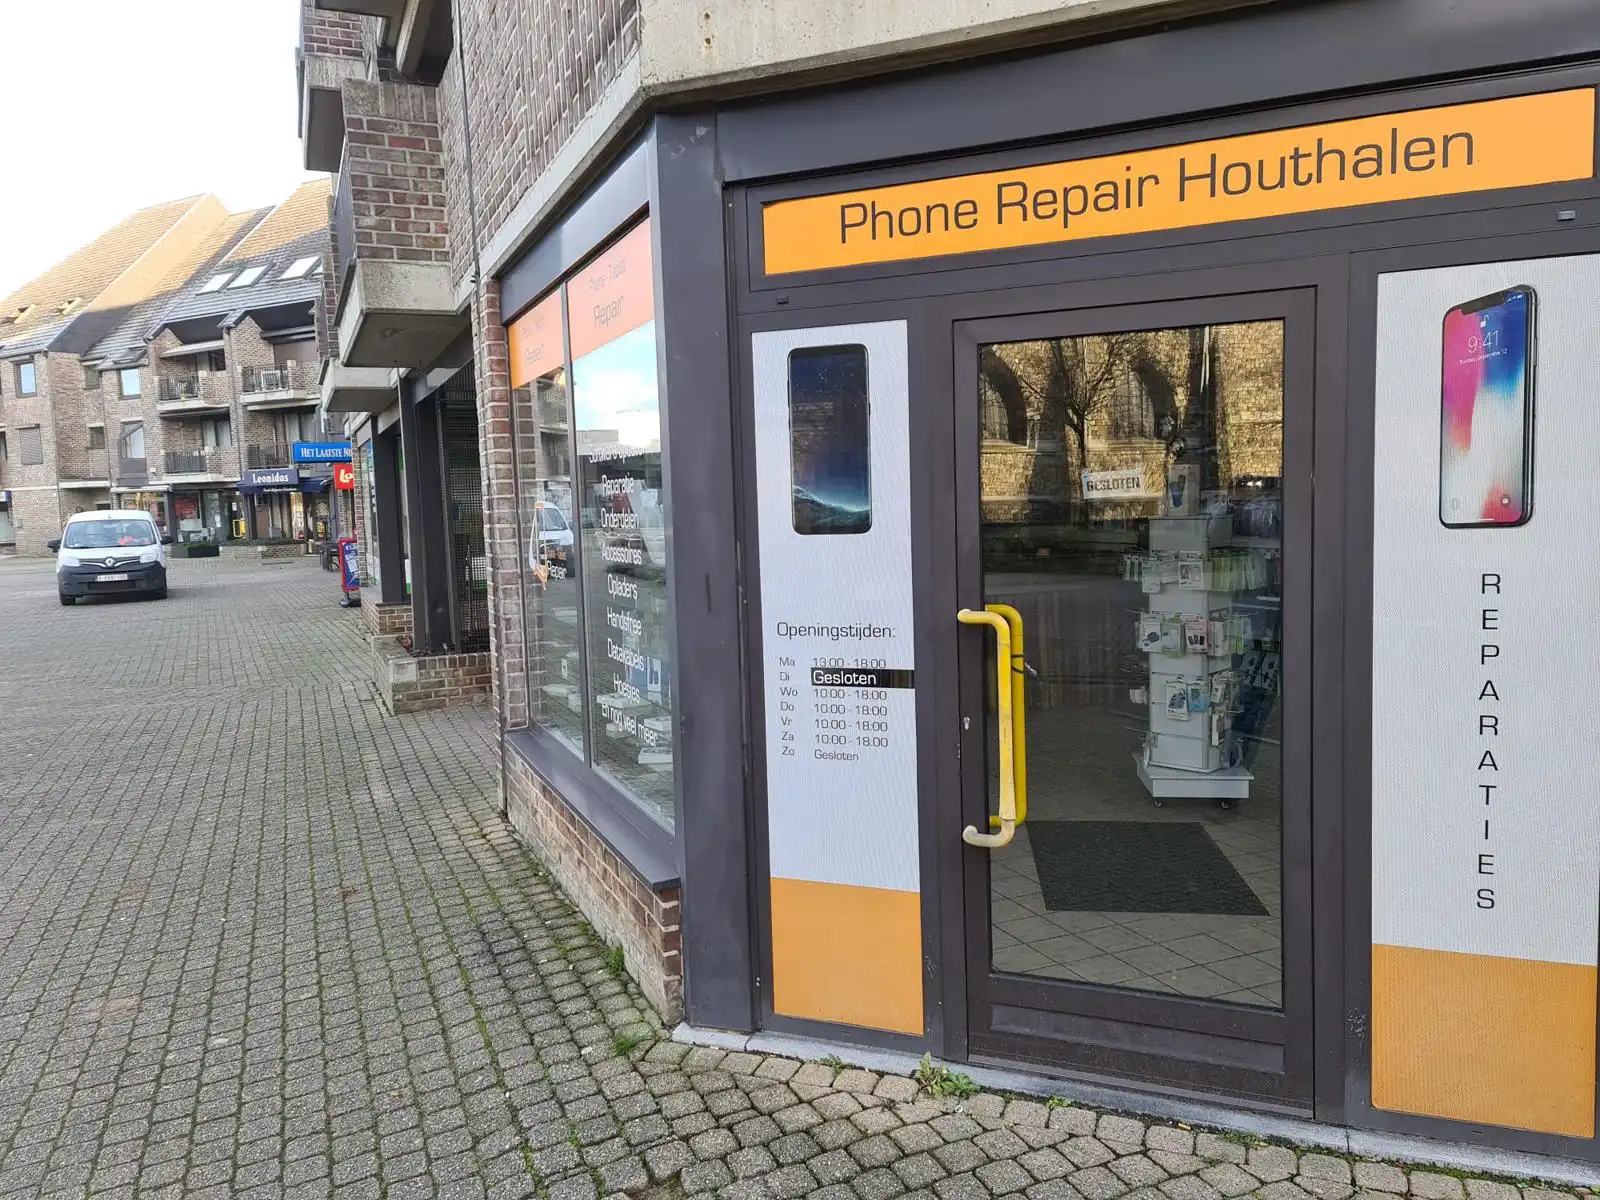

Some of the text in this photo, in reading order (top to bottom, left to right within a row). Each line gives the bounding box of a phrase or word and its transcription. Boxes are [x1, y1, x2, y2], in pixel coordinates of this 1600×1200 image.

[838, 126, 1474, 245] Phone Repair Houthalen
[593, 293, 626, 329] Repair
[1467, 329, 1500, 354] 9:41
[300, 447, 315, 458] HET
[315, 447, 343, 458] LAATSTE
[252, 471, 289, 484] Leonidas
[601, 472, 635, 495] Reparatie
[1086, 476, 1141, 492] GESLOTEN
[600, 508, 639, 529] Onderdelen
[601, 542, 643, 565] Accessoires
[607, 573, 638, 600] Opladers
[606, 605, 642, 636] Handsfree
[776, 621, 896, 641] Openingstijden:
[607, 637, 645, 672] Datakabels
[779, 656, 796, 667] Ma
[812, 657, 845, 668] 13:00
[853, 658, 886, 669] 18:00
[779, 669, 877, 685] Di Gesloten
[613, 672, 641, 704] Hoesjes
[780, 686, 798, 697] Wo
[813, 688, 845, 699] 10:00
[854, 690, 887, 701] 18:00
[780, 701, 795, 712] Do
[814, 703, 846, 714] 10:00
[855, 705, 888, 716] 18:00
[601, 702, 658, 747] En nog veel meer
[780, 716, 793, 726] Vr
[814, 719, 846, 730] 10:00
[855, 721, 888, 732] 18:00
[781, 731, 795, 742] Za
[814, 734, 847, 745] 10:00
[856, 737, 888, 748] 18:00
[1476, 572, 1501, 910] REPARATIES
[781, 746, 859, 761] Zo Gesloten
